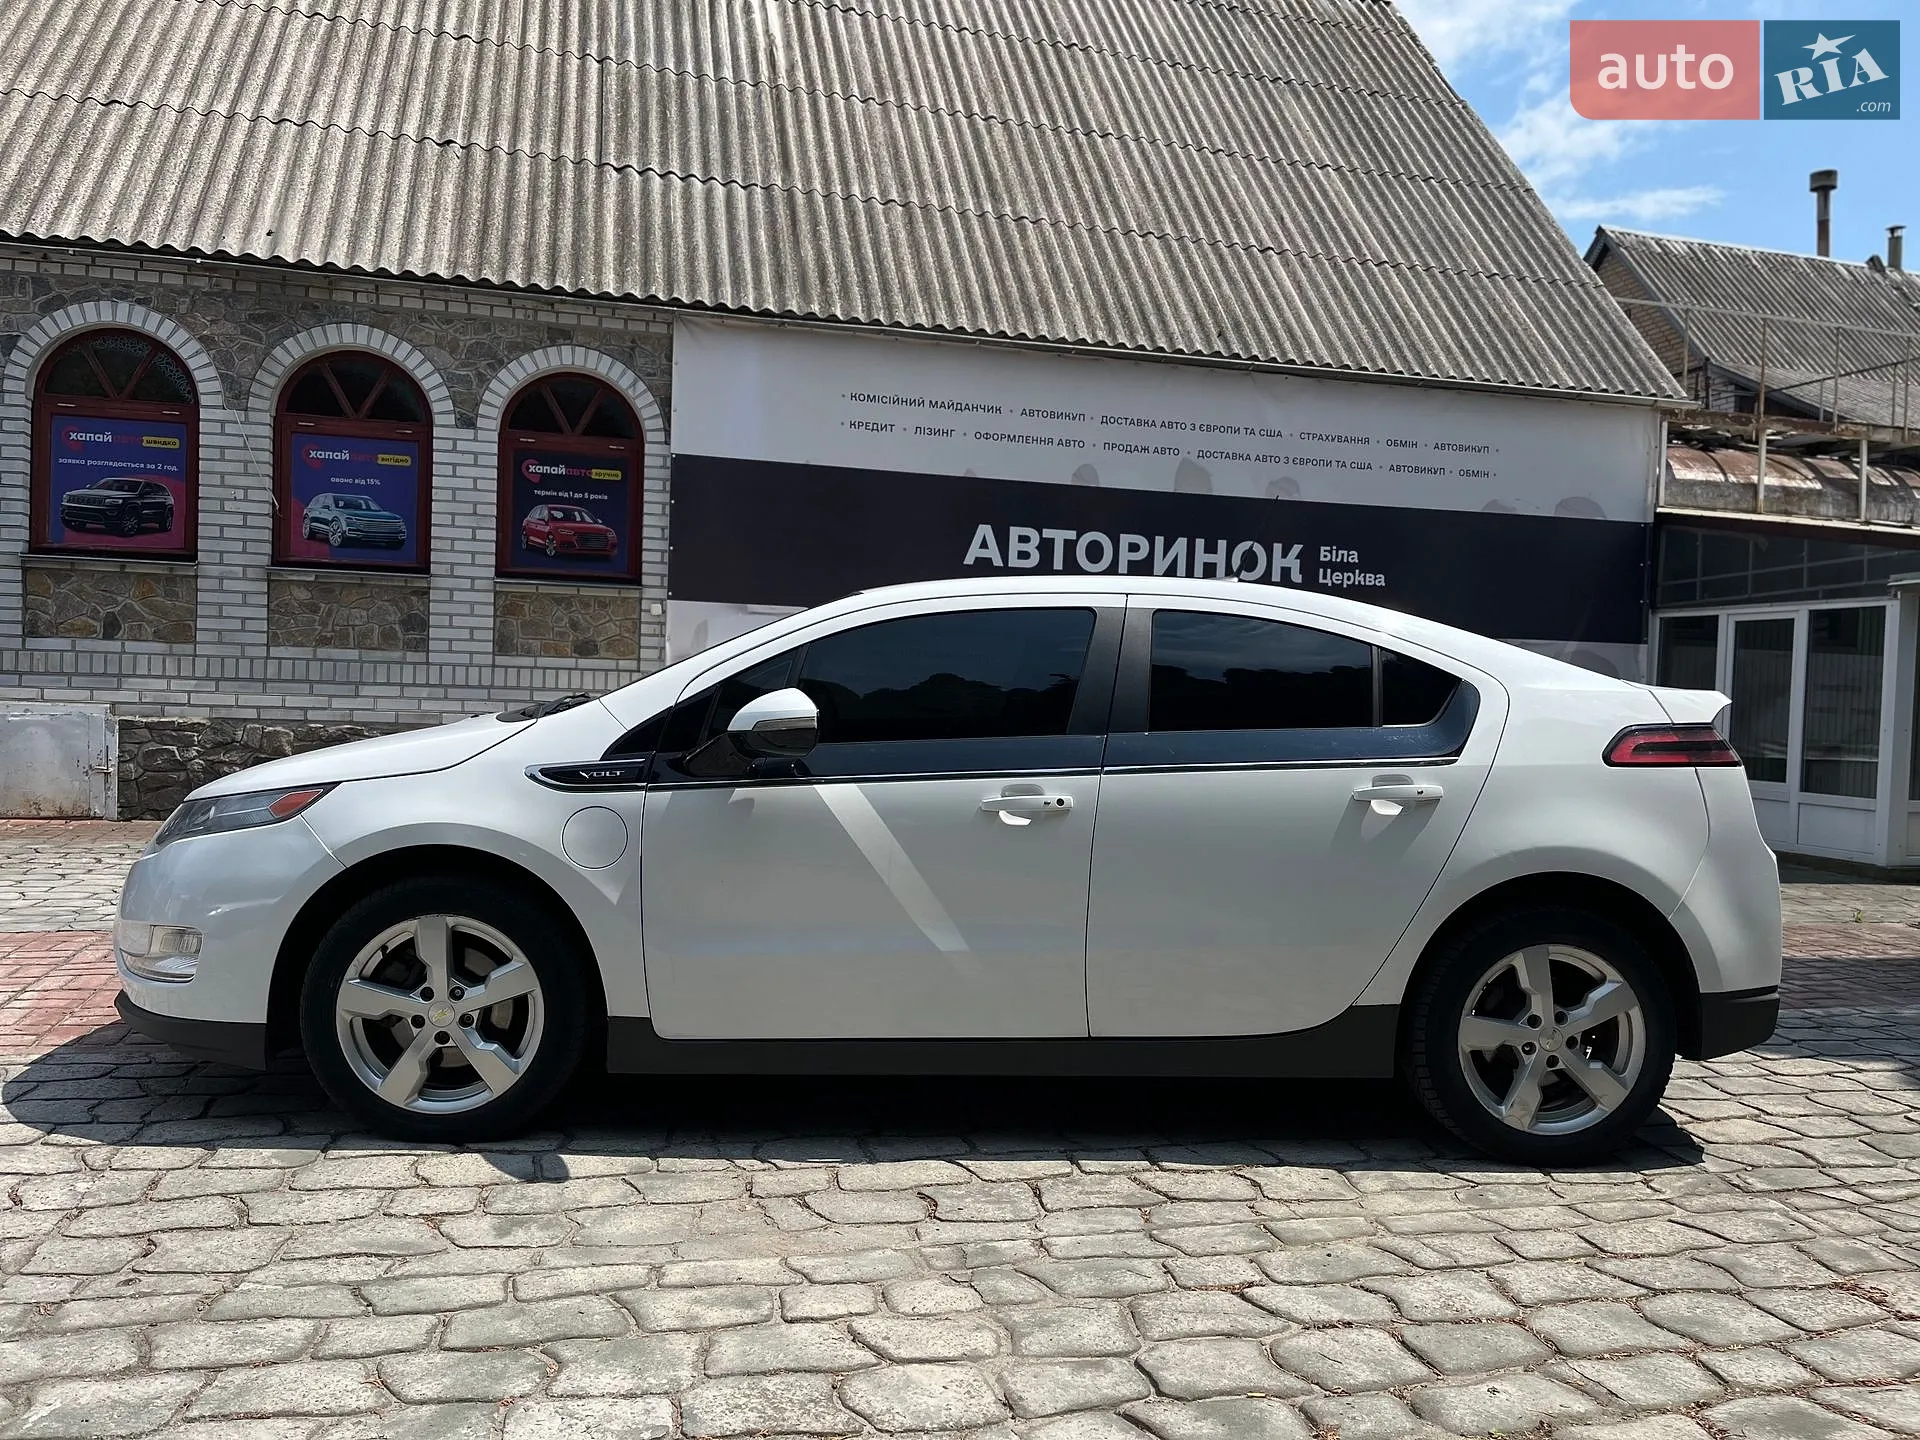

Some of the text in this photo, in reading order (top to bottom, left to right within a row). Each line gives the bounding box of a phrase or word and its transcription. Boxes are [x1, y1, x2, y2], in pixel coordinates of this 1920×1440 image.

[850, 392, 925, 408] КОМІСІЙНИЙ
[928, 399, 1002, 415] МАЙДАНЧИК
[1020, 408, 1086, 422] АВТОВИКУП
[1100, 415, 1157, 429] ДОСТАВКА
[1159, 421, 1187, 431] АВТО
[1198, 423, 1241, 436] ЄВРОПИ
[1243, 427, 1256, 436] ТА
[1258, 428, 1283, 438] США
[1299, 432, 1370, 445] СТРАХУВАННЯ
[1386, 438, 1418, 449] ОБМІН
[1433, 442, 1490, 454] АВТОВИКУП
[849, 420, 896, 433] КРЕДИТ
[914, 426, 956, 438] ЛІЗИНГ
[974, 431, 1054, 446] ОФОРМЛЕННЯ
[1057, 438, 1085, 449] АВТО
[1103, 441, 1150, 454] ПРОДАЖ
[1152, 446, 1180, 456] АВТО
[1197, 449, 1252, 462] ДОСТАВКА
[1254, 454, 1281, 464] АВТО
[1292, 457, 1332, 468] ЄВРОПИ
[1335, 460, 1347, 469] ТА
[1349, 461, 1373, 471] США
[1388, 464, 1445, 476] АВТОВИКУП
[1458, 469, 1490, 479] ОБМІН
[367, 478, 381, 486] 15%
[963, 524, 1305, 584] АВТОРИНОК
[1319, 545, 1359, 564] Біла
[1318, 567, 1386, 588] Церква
[579, 770, 625, 779] VOLT
